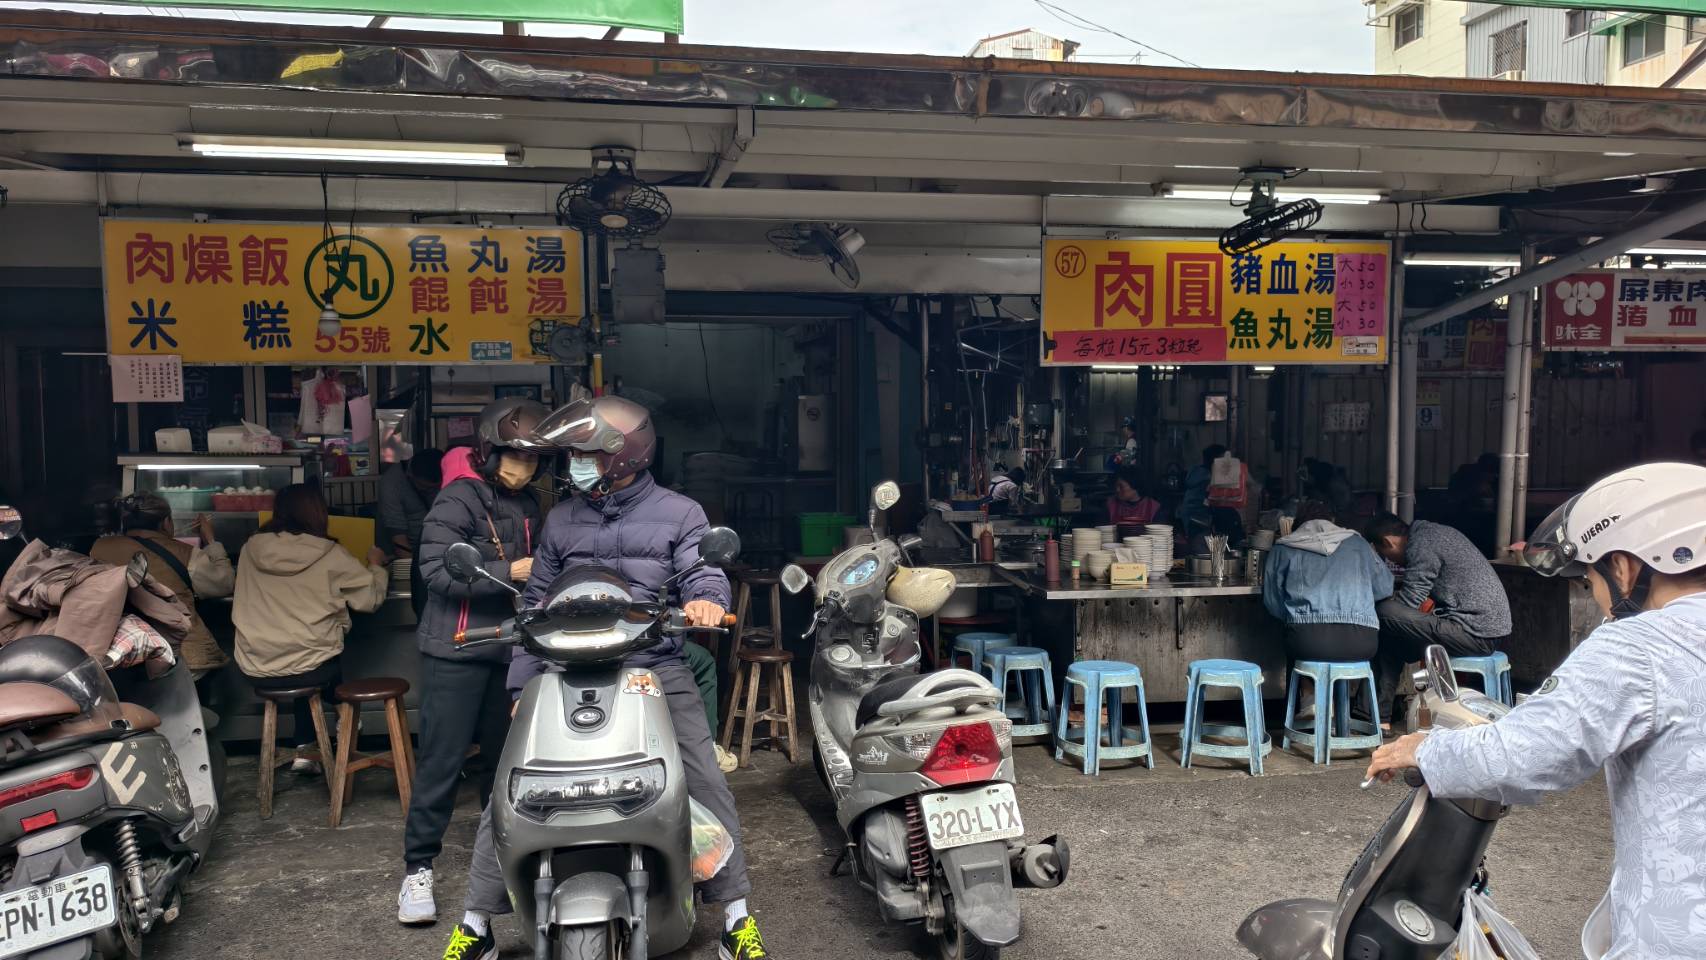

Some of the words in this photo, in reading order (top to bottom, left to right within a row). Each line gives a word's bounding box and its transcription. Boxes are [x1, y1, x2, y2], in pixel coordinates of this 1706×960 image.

[125, 233, 290, 286] 肉燥飯
[408, 235, 567, 274] 魚丸湯
[1060, 251, 1080, 274] 57
[1230, 252, 1336, 295] 豬血湯
[1358, 262, 1376, 272] 50
[410, 275, 568, 315] 餛飩湯
[1094, 251, 1223, 327] 肉圓
[1359, 279, 1376, 290] 30
[127, 298, 292, 351] 米糕
[314, 326, 390, 354] 55號
[409, 318, 450, 355] 水
[1229, 307, 1335, 350] 魚丸湯
[1358, 318, 1376, 330] 30
[1555, 323, 1602, 340] 味全
